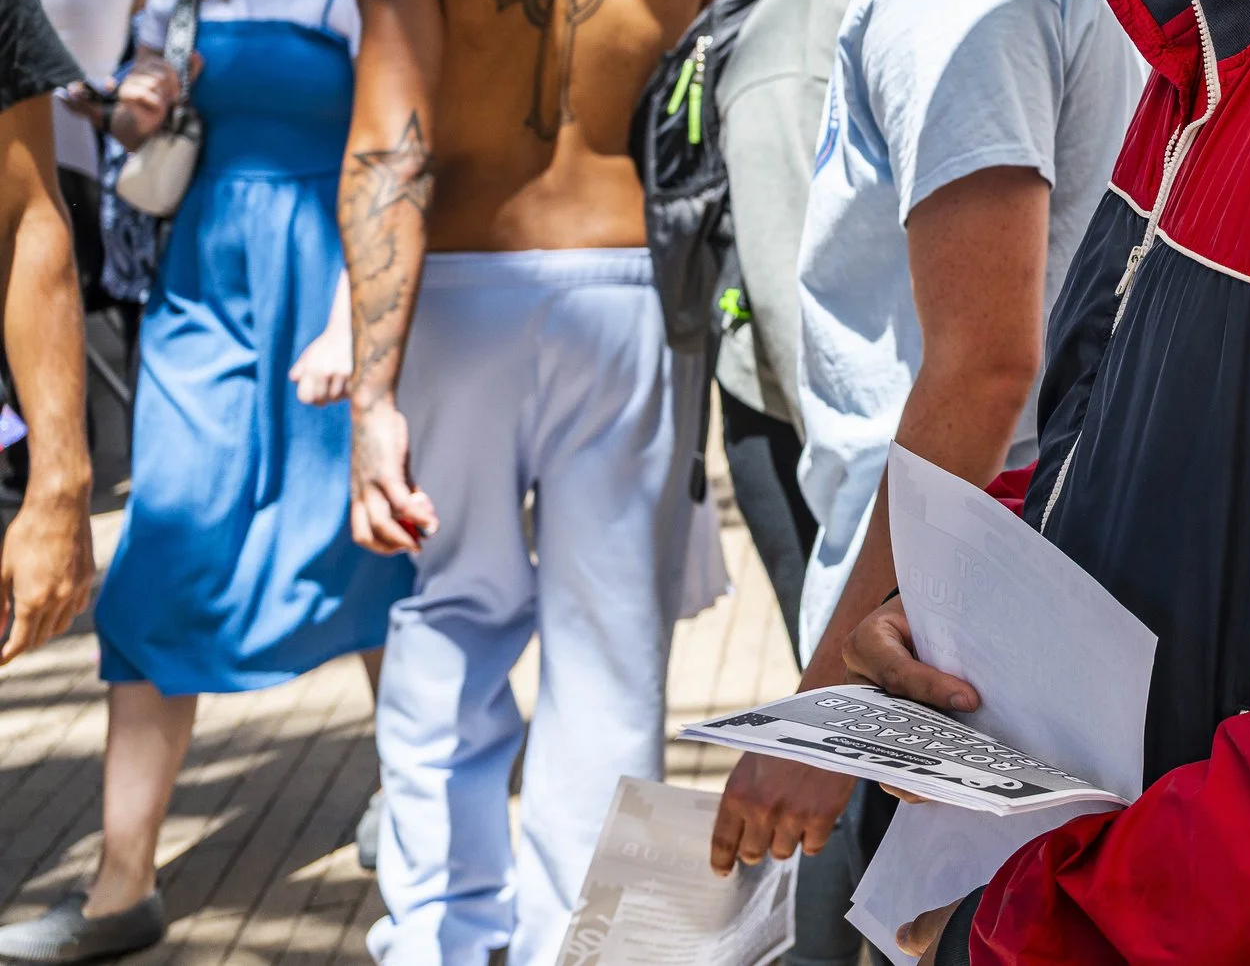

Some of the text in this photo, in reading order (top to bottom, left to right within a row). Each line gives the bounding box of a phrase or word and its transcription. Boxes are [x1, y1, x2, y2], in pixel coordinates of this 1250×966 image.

[815, 698, 911, 724] CLUB
[823, 718, 1025, 772] ROTARACT
[829, 737, 936, 765] Santa Monica College
[911, 724, 1092, 785] BUSINESS
